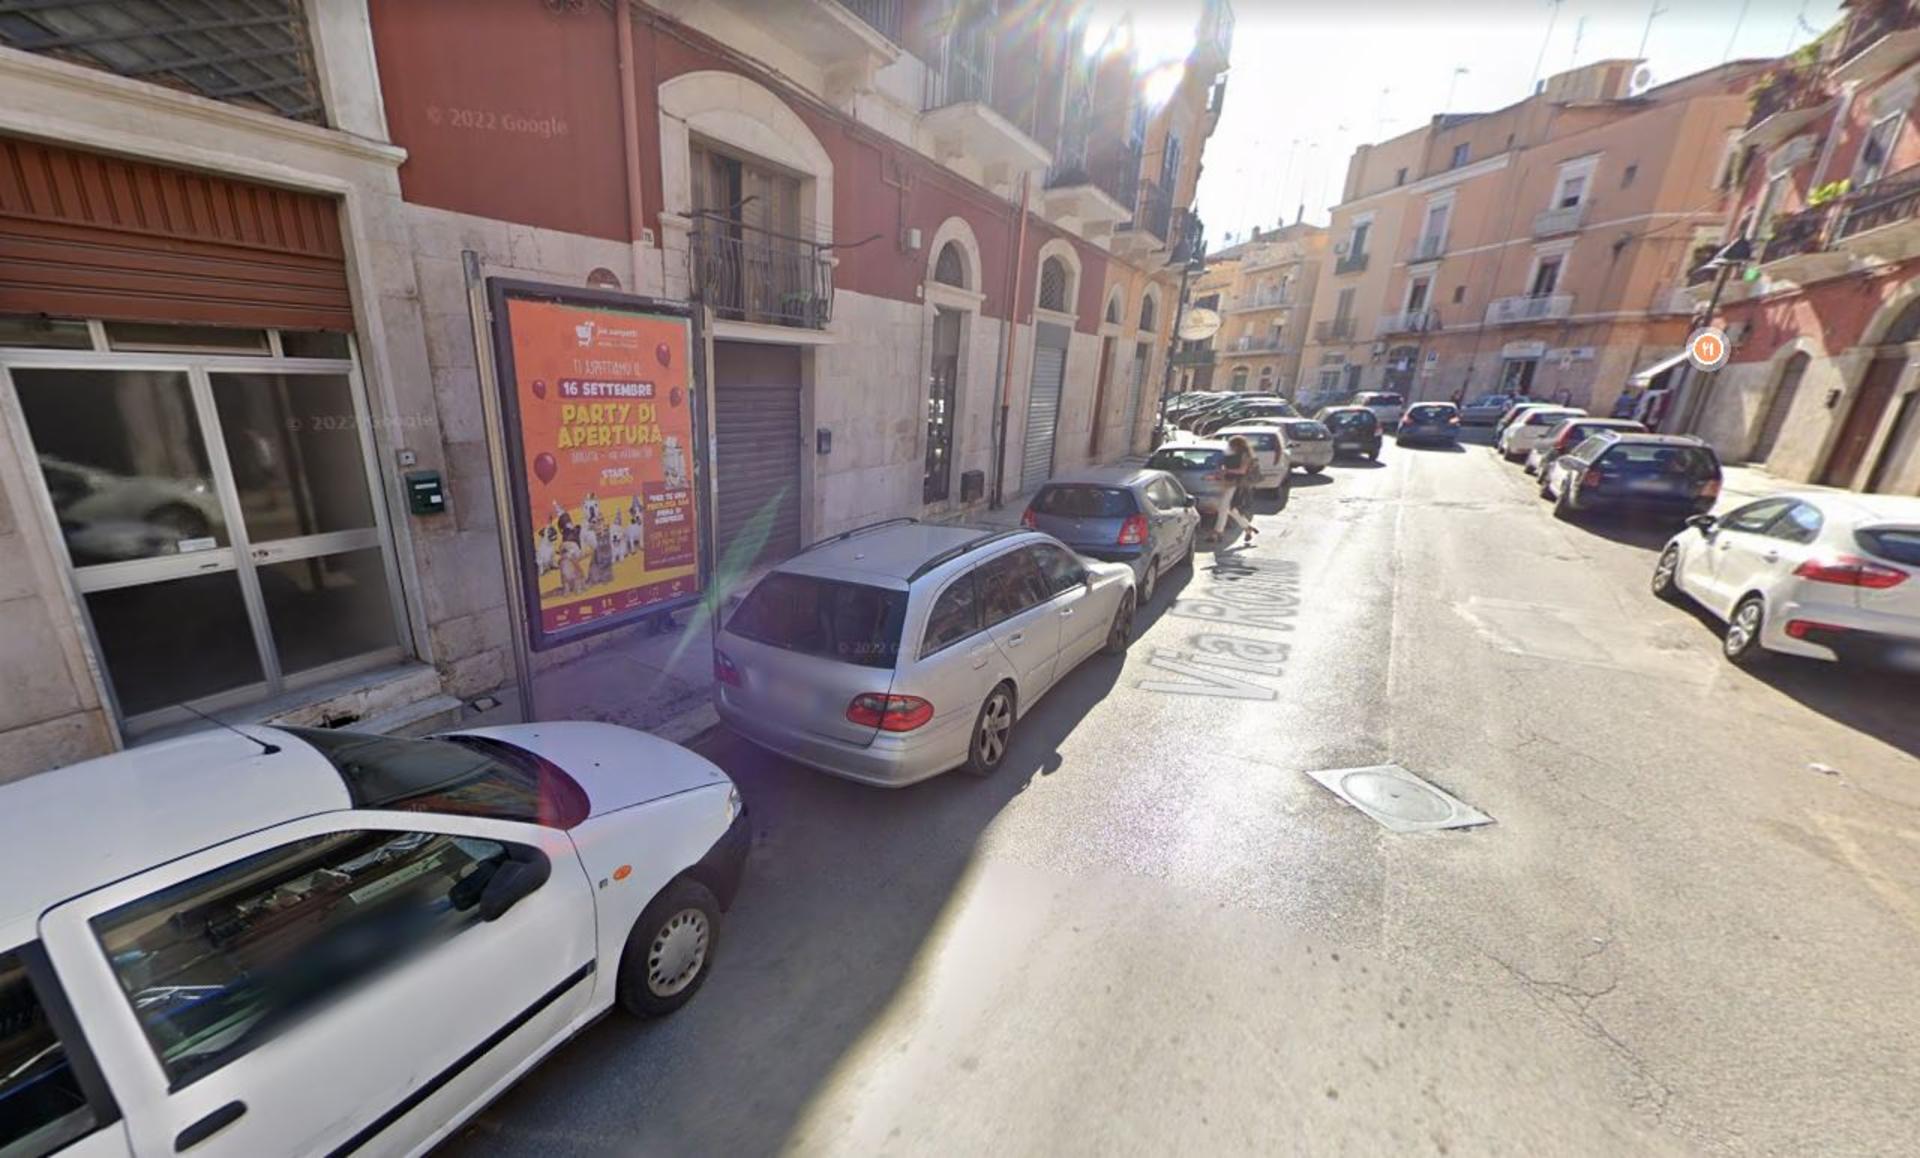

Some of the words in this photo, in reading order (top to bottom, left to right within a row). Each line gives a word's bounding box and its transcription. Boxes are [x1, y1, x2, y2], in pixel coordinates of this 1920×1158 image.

[563, 382, 578, 396] 16
[583, 382, 652, 396] SETTEMBRE
[562, 403, 631, 424] PARTY
[639, 403, 657, 423] DI
[558, 423, 662, 449] APERTURA
